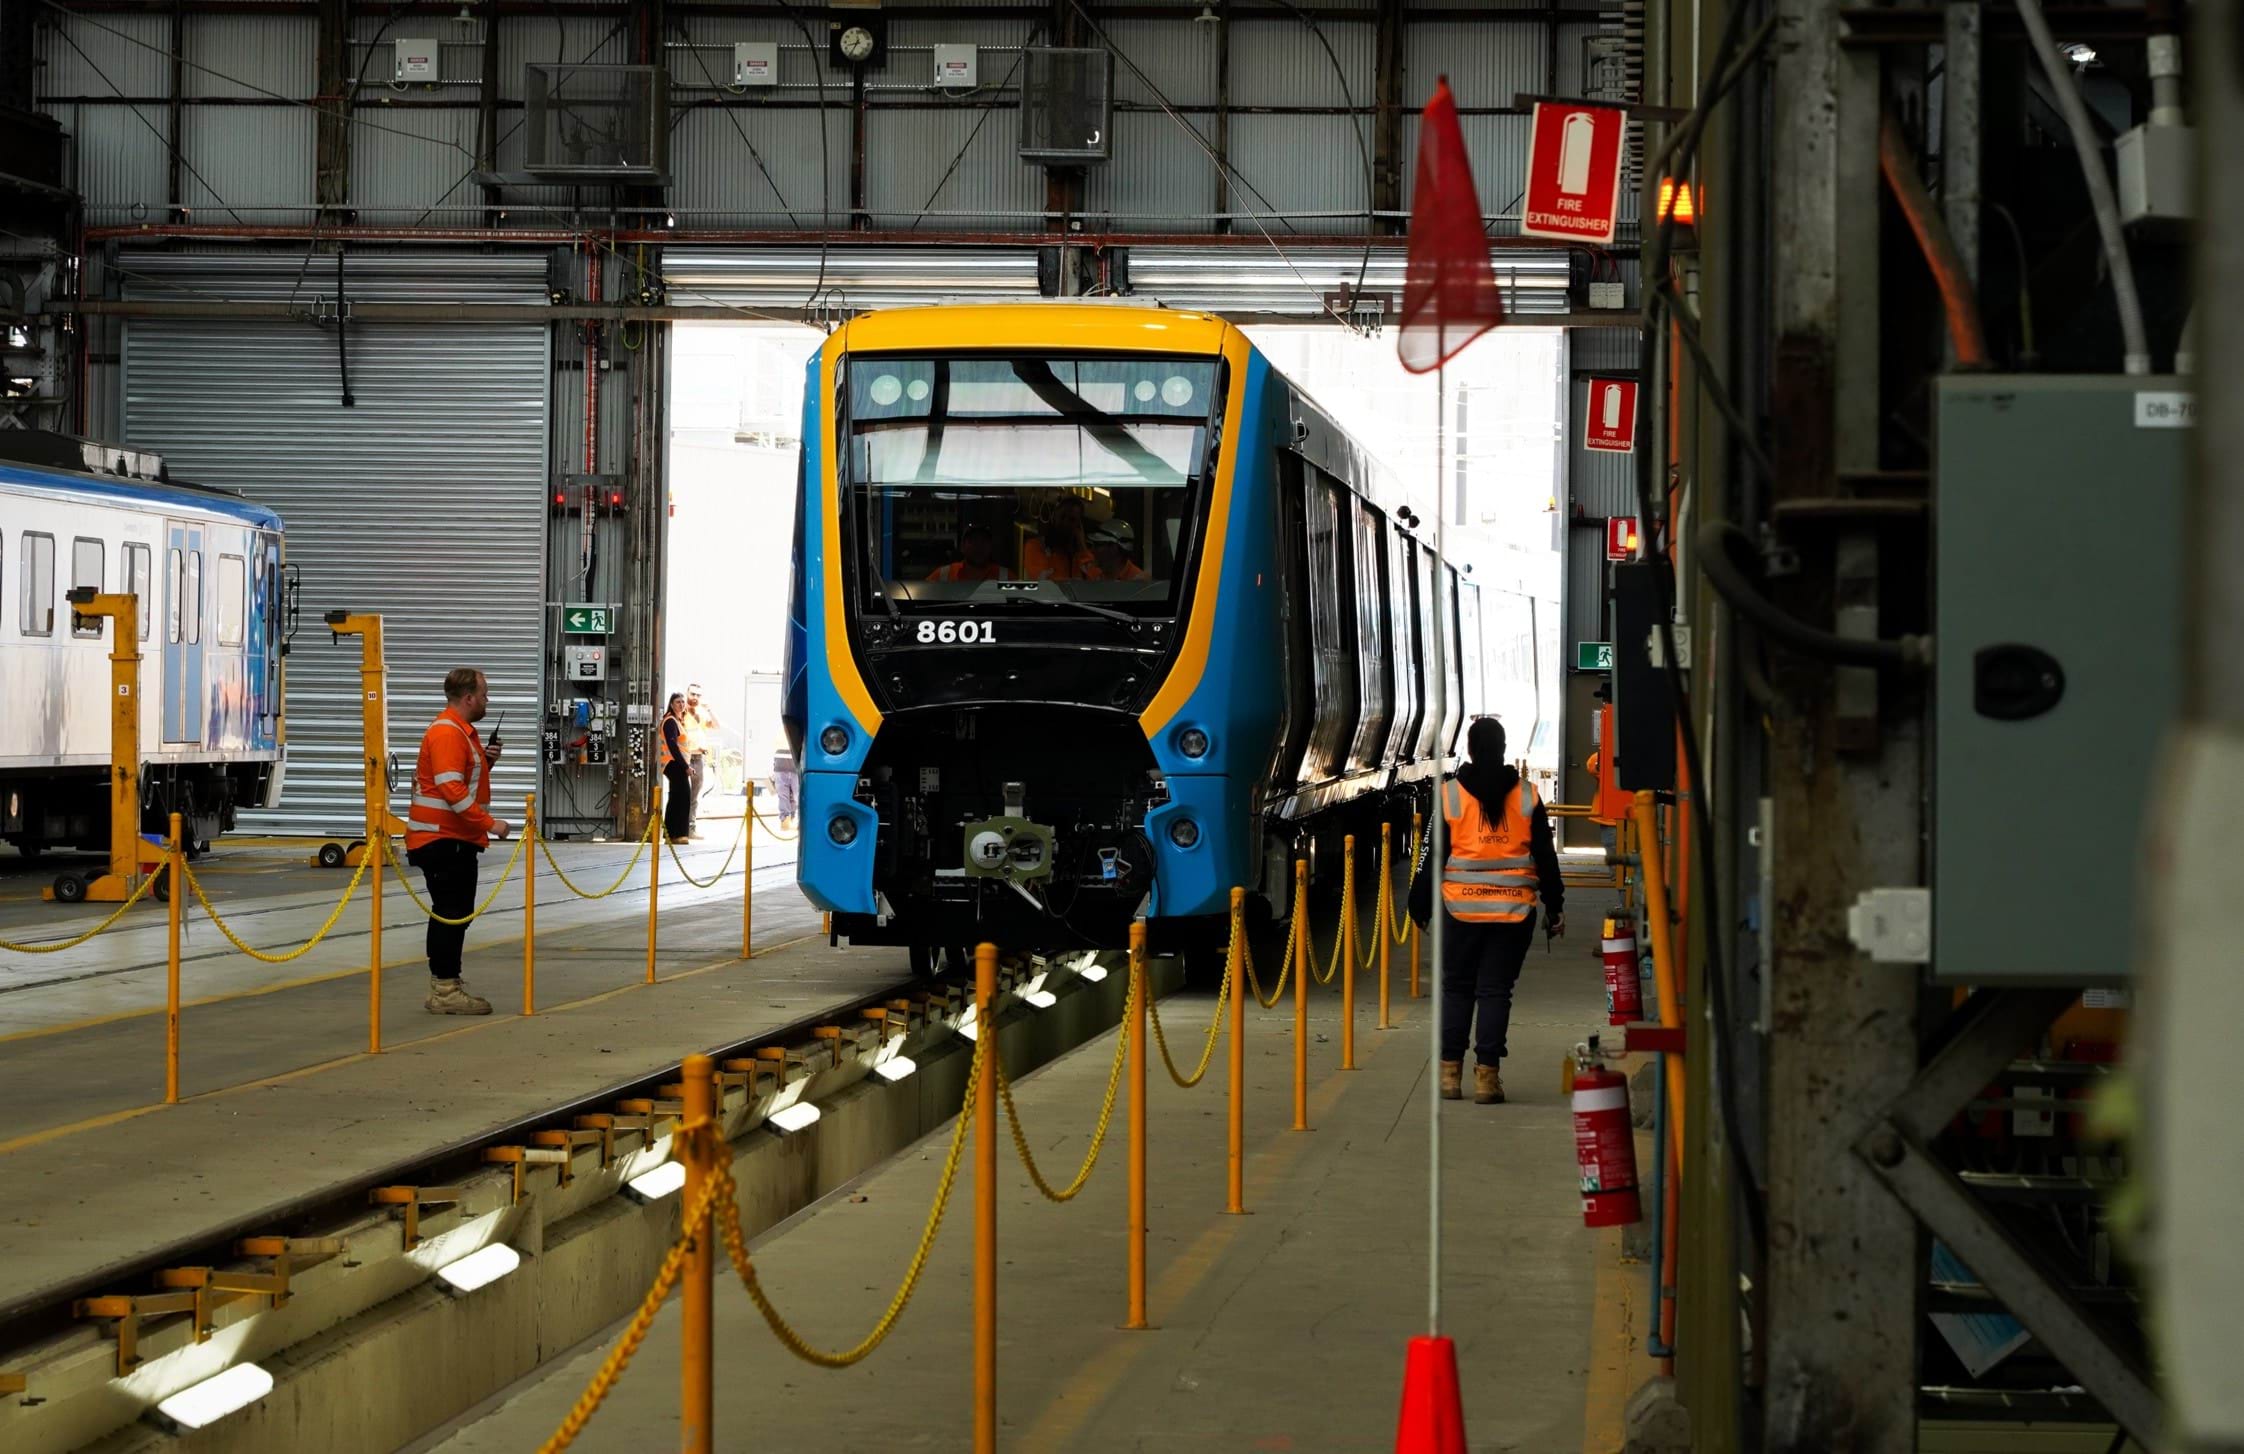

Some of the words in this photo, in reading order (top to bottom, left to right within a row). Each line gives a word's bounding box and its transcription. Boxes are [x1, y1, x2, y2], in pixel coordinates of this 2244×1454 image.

[1557, 198, 1583, 212] FIRE
[1527, 211, 1609, 231] EXTINGUISHER
[1603, 430, 1617, 438] FIRE
[1588, 437, 1631, 448] EXTINGUISHER
[916, 620, 996, 643] 8601
[120, 686, 128, 694] 3
[545, 732, 558, 740] 384
[549, 742, 554, 750] 3
[594, 743, 599, 751] 3
[594, 752, 599, 761] 5
[1479, 836, 1509, 844] METRO
[1416, 845, 1429, 873] Stock
[1462, 888, 1523, 897] CO-ORDINATOR
